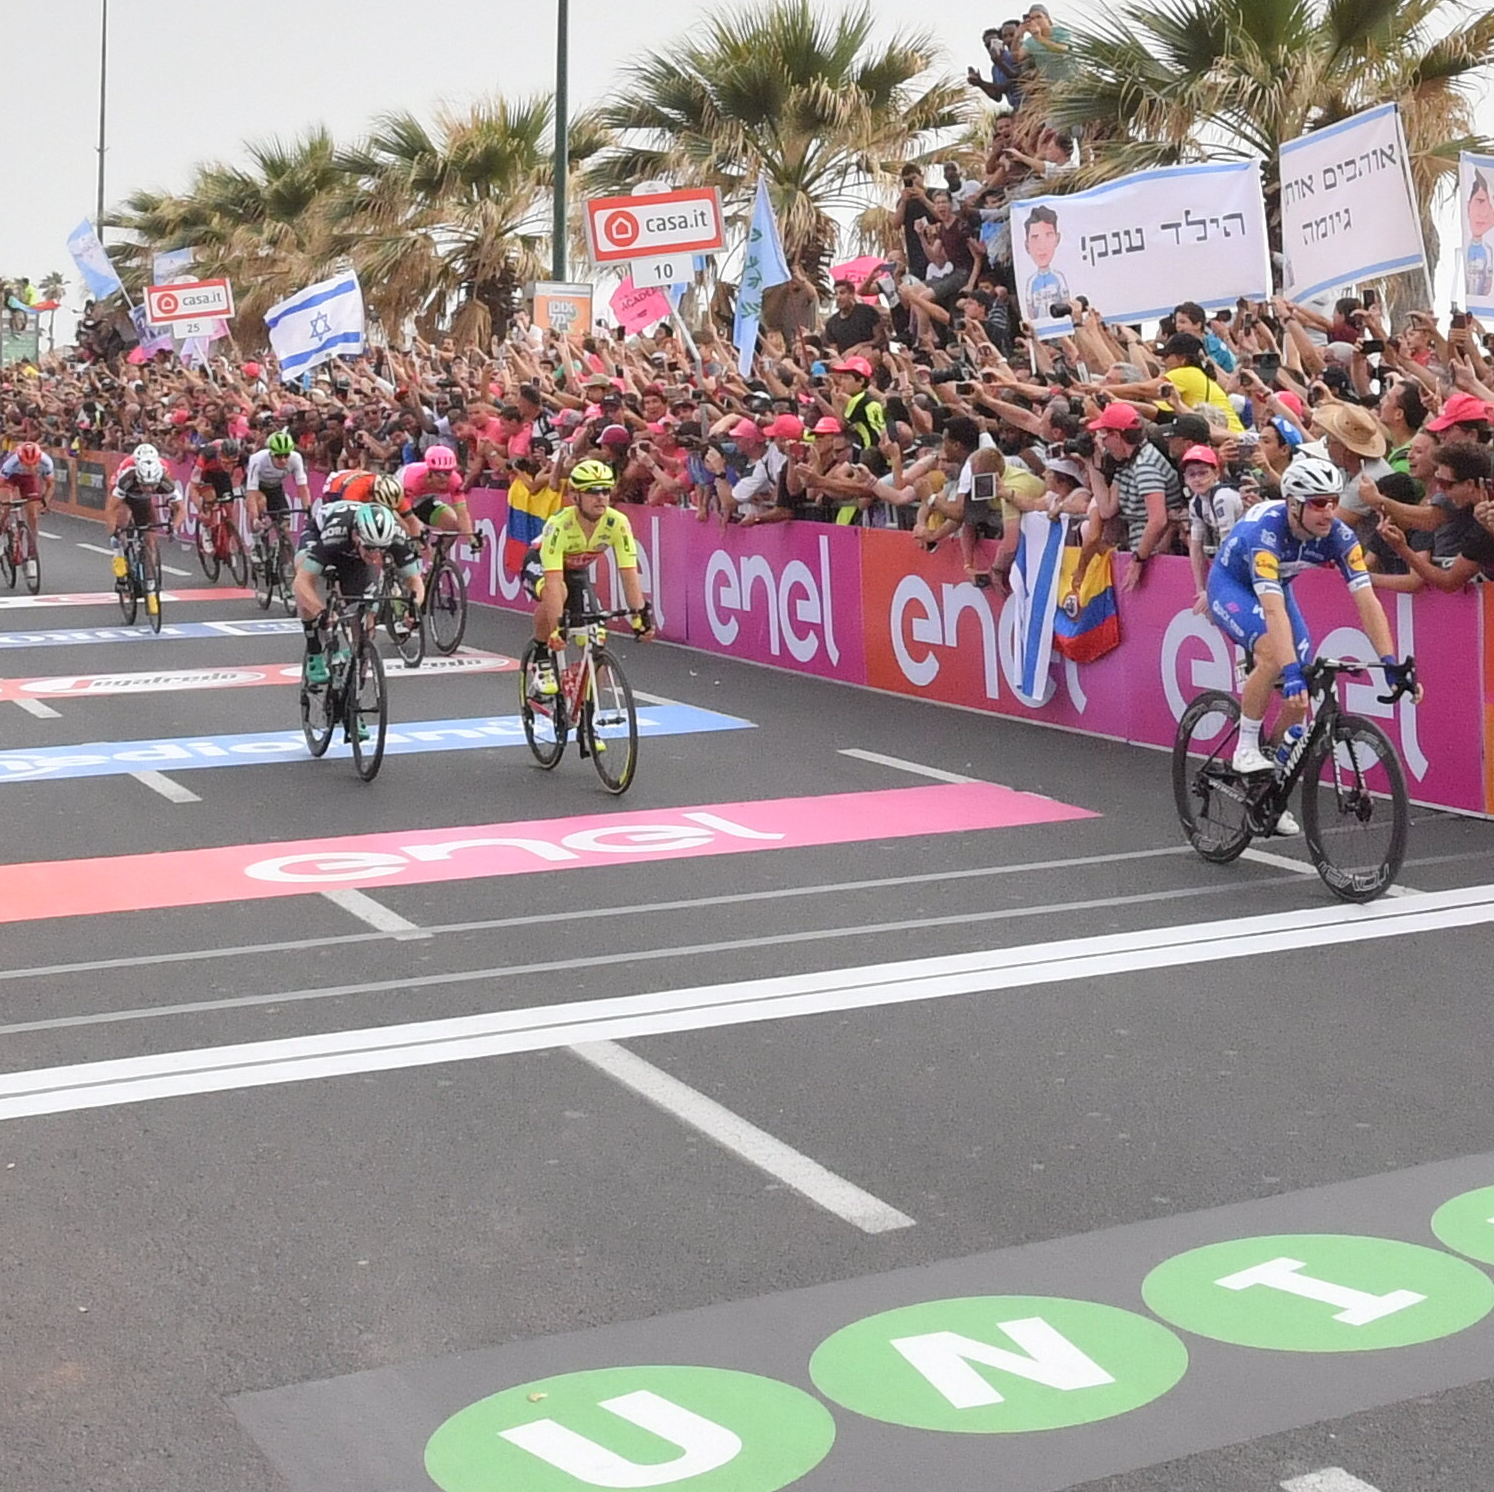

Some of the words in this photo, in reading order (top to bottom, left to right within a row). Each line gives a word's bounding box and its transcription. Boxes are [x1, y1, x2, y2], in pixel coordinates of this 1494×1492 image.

[646, 209, 708, 233] casa.it
[1160, 210, 1245, 245] הילד
[1080, 227, 1145, 267] ענק!
[654, 264, 673, 279] 10
[182, 291, 223, 307] casa.it
[187, 324, 200, 333] 25
[707, 536, 840, 666] enel
[1160, 594, 1429, 783] eel
[244, 811, 786, 883] enel
